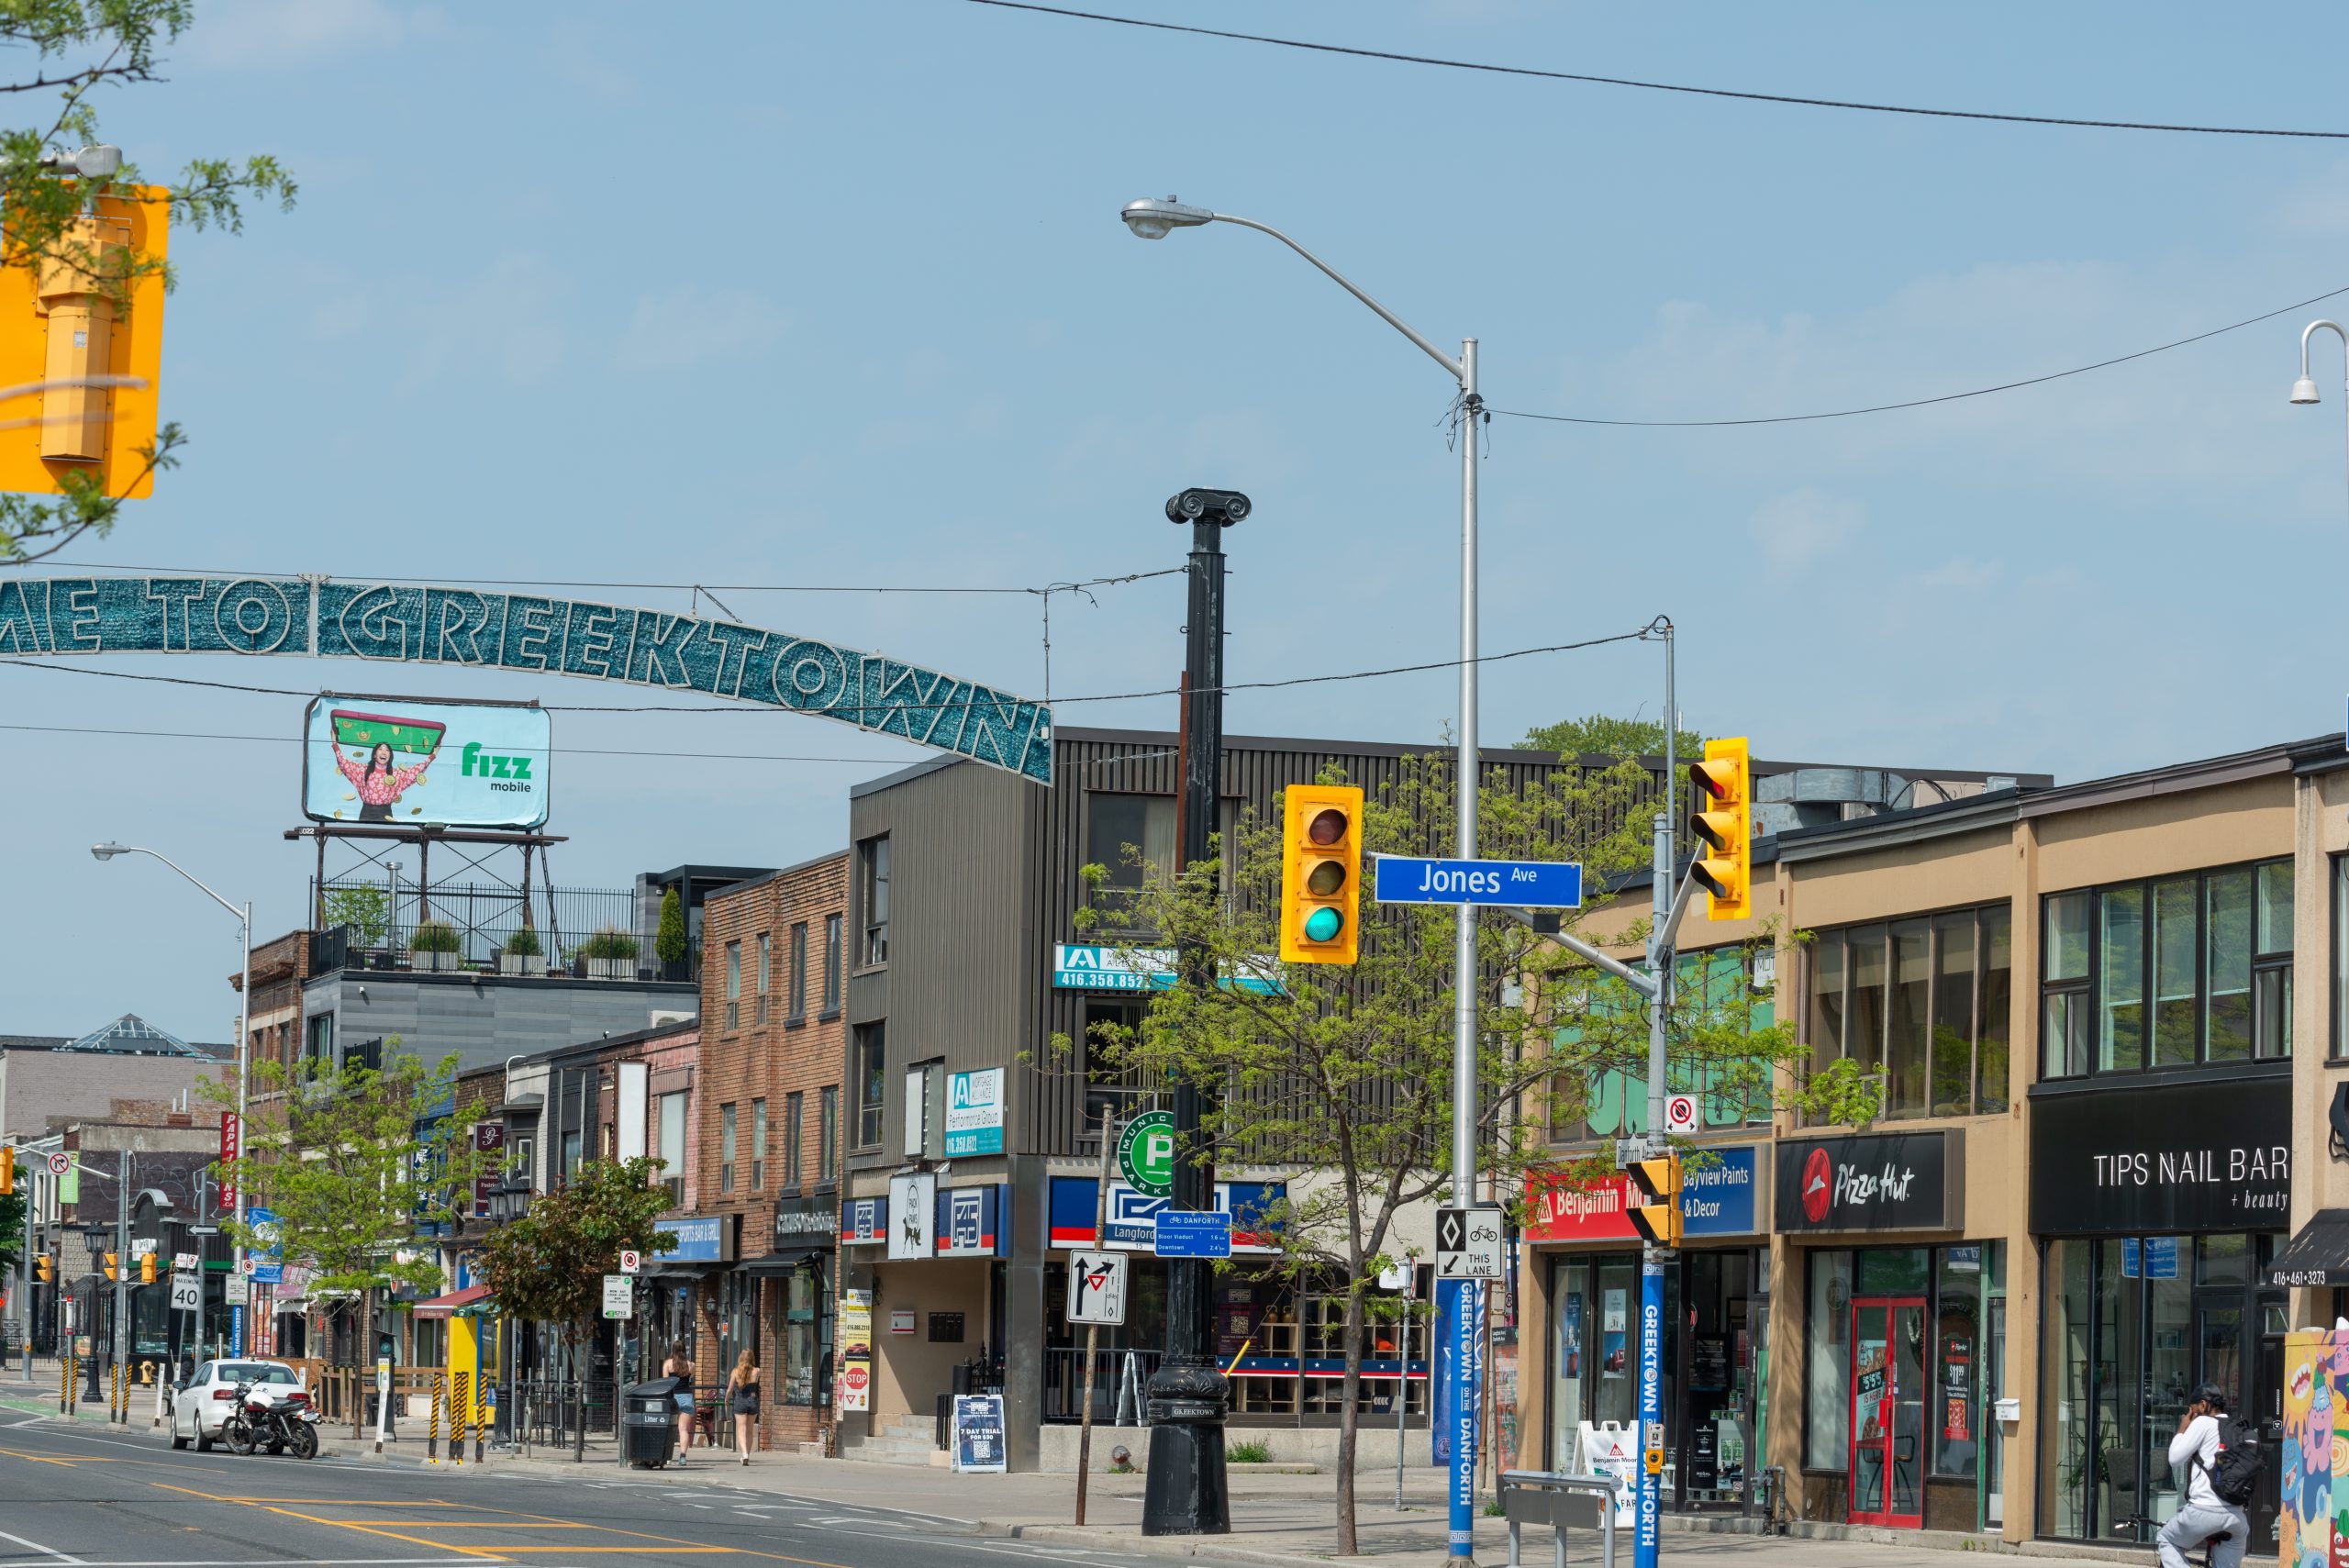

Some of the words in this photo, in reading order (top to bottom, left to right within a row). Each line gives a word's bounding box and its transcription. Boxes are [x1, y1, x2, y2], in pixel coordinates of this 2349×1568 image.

[147, 576, 291, 655] TO
[339, 584, 1045, 775] GREEKTOWN
[462, 741, 532, 780] fizz
[490, 781, 531, 793] mobile
[1419, 863, 1501, 894] Jones
[1510, 867, 1538, 883] Ave
[226, 1114, 236, 1151] PAPA
[949, 1113, 980, 1129] Performance
[981, 1110, 998, 1125] Group
[1122, 1115, 1174, 1150] MUNIC
[1618, 1145, 1641, 1162] Danforth
[2093, 1152, 2150, 1187] TIPS
[2158, 1150, 2221, 1184] NAIL
[2229, 1146, 2289, 1182] BAR
[1122, 1160, 1173, 1195] PARK
[1683, 1168, 1721, 1192] Bayview
[1721, 1165, 1749, 1184] Paints
[1834, 1162, 1879, 1207] Pizza
[1879, 1162, 1916, 1204] Hut
[1556, 1179, 1619, 1224] Benjamin
[1685, 1201, 1692, 1218] &
[1693, 1198, 1720, 1218] Decor
[2244, 1189, 2288, 1211] beauty
[1115, 1226, 1155, 1241] Langford
[1184, 1217, 1220, 1225] DANFORTH
[1465, 1265, 1493, 1275] LANE
[1469, 1253, 1490, 1263] THIS
[174, 1288, 198, 1306] 40
[1461, 1282, 1473, 1382] GREEKTOWN
[1644, 1305, 1658, 1412] GREEKTOWN
[847, 1373, 867, 1384] STOP
[644, 1415, 659, 1423] Litter
[1461, 1418, 1472, 1506] DANFORTH
